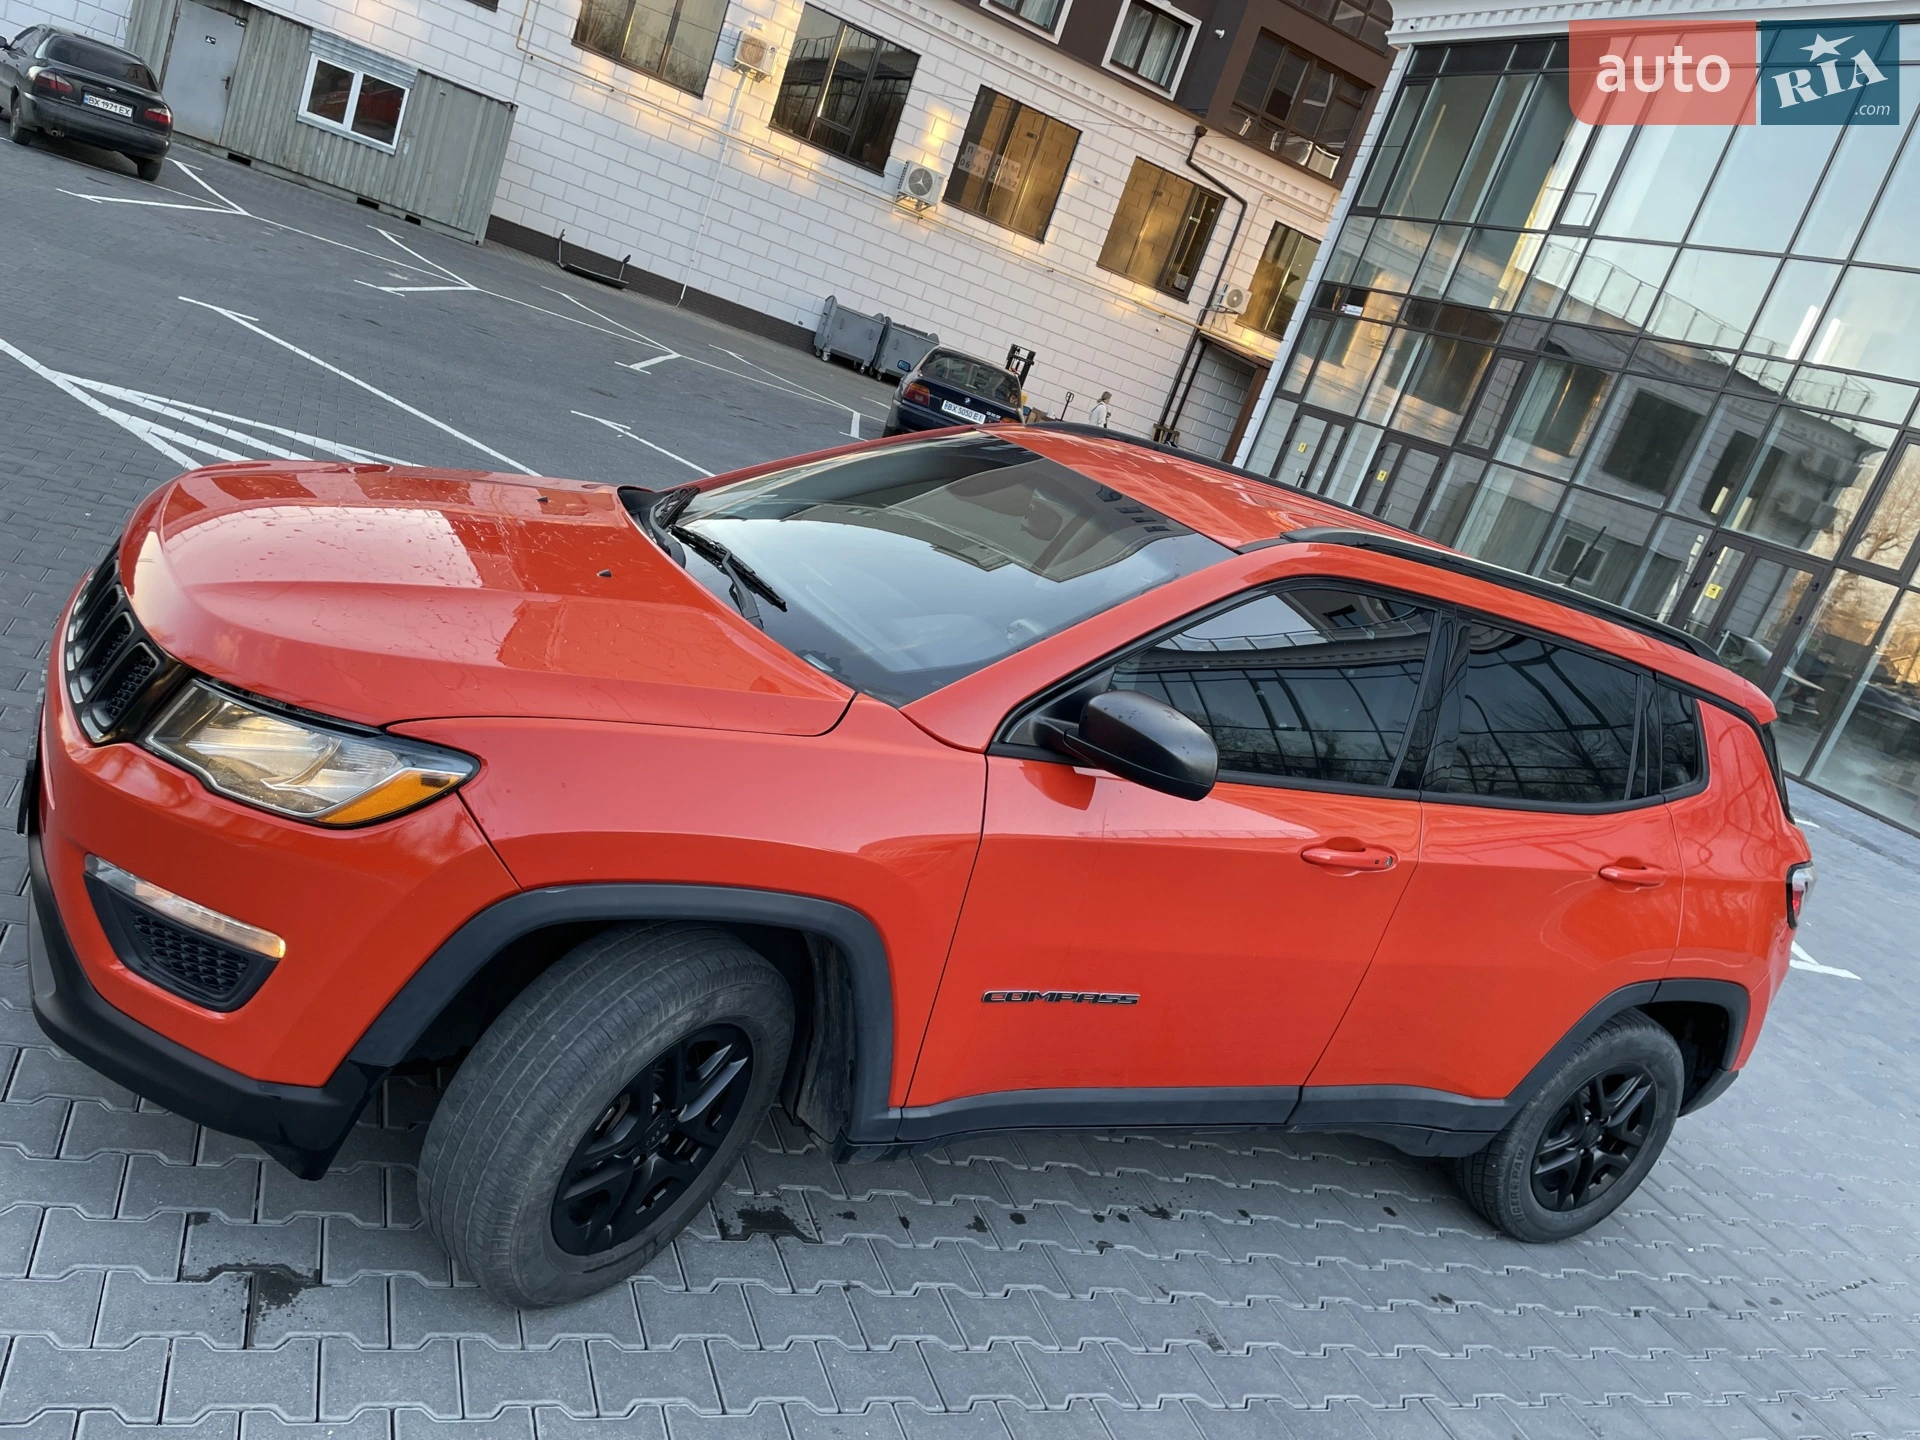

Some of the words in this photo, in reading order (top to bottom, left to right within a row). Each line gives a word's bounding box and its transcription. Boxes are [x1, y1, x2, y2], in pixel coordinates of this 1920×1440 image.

[88, 96, 101, 107] BX
[102, 101, 118, 112] 1971
[119, 106, 131, 116] EX
[948, 403, 958, 413] BX
[958, 407, 973, 418] 5050
[981, 990, 1141, 1005] COMPASS
[1512, 1147, 1526, 1179] PAW
[1509, 1191, 1525, 1222] TIGER
